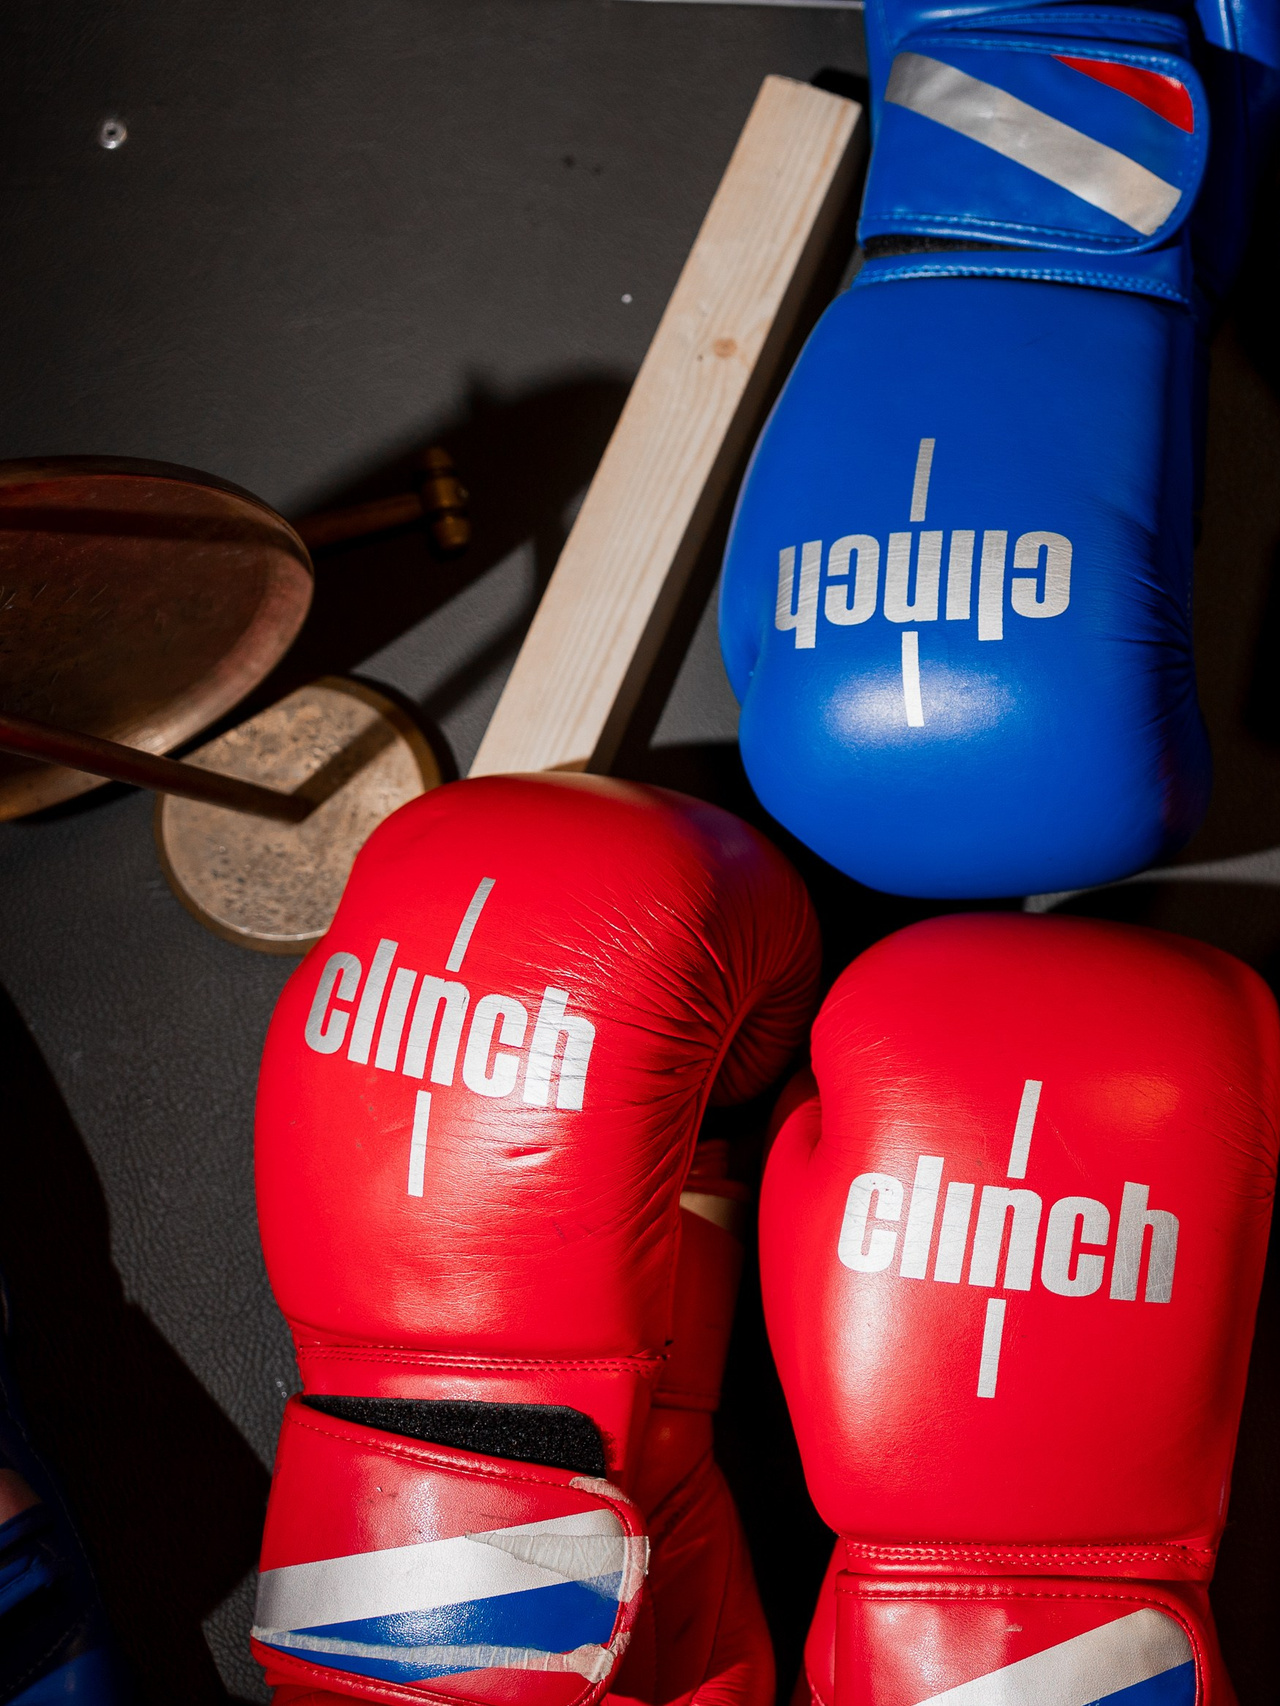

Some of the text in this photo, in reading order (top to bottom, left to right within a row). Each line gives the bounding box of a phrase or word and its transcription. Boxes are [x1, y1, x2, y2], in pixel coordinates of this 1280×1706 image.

[774, 529, 1073, 650] clinch
[304, 937, 597, 1112] clinch
[837, 1154, 1181, 1304] clinch
